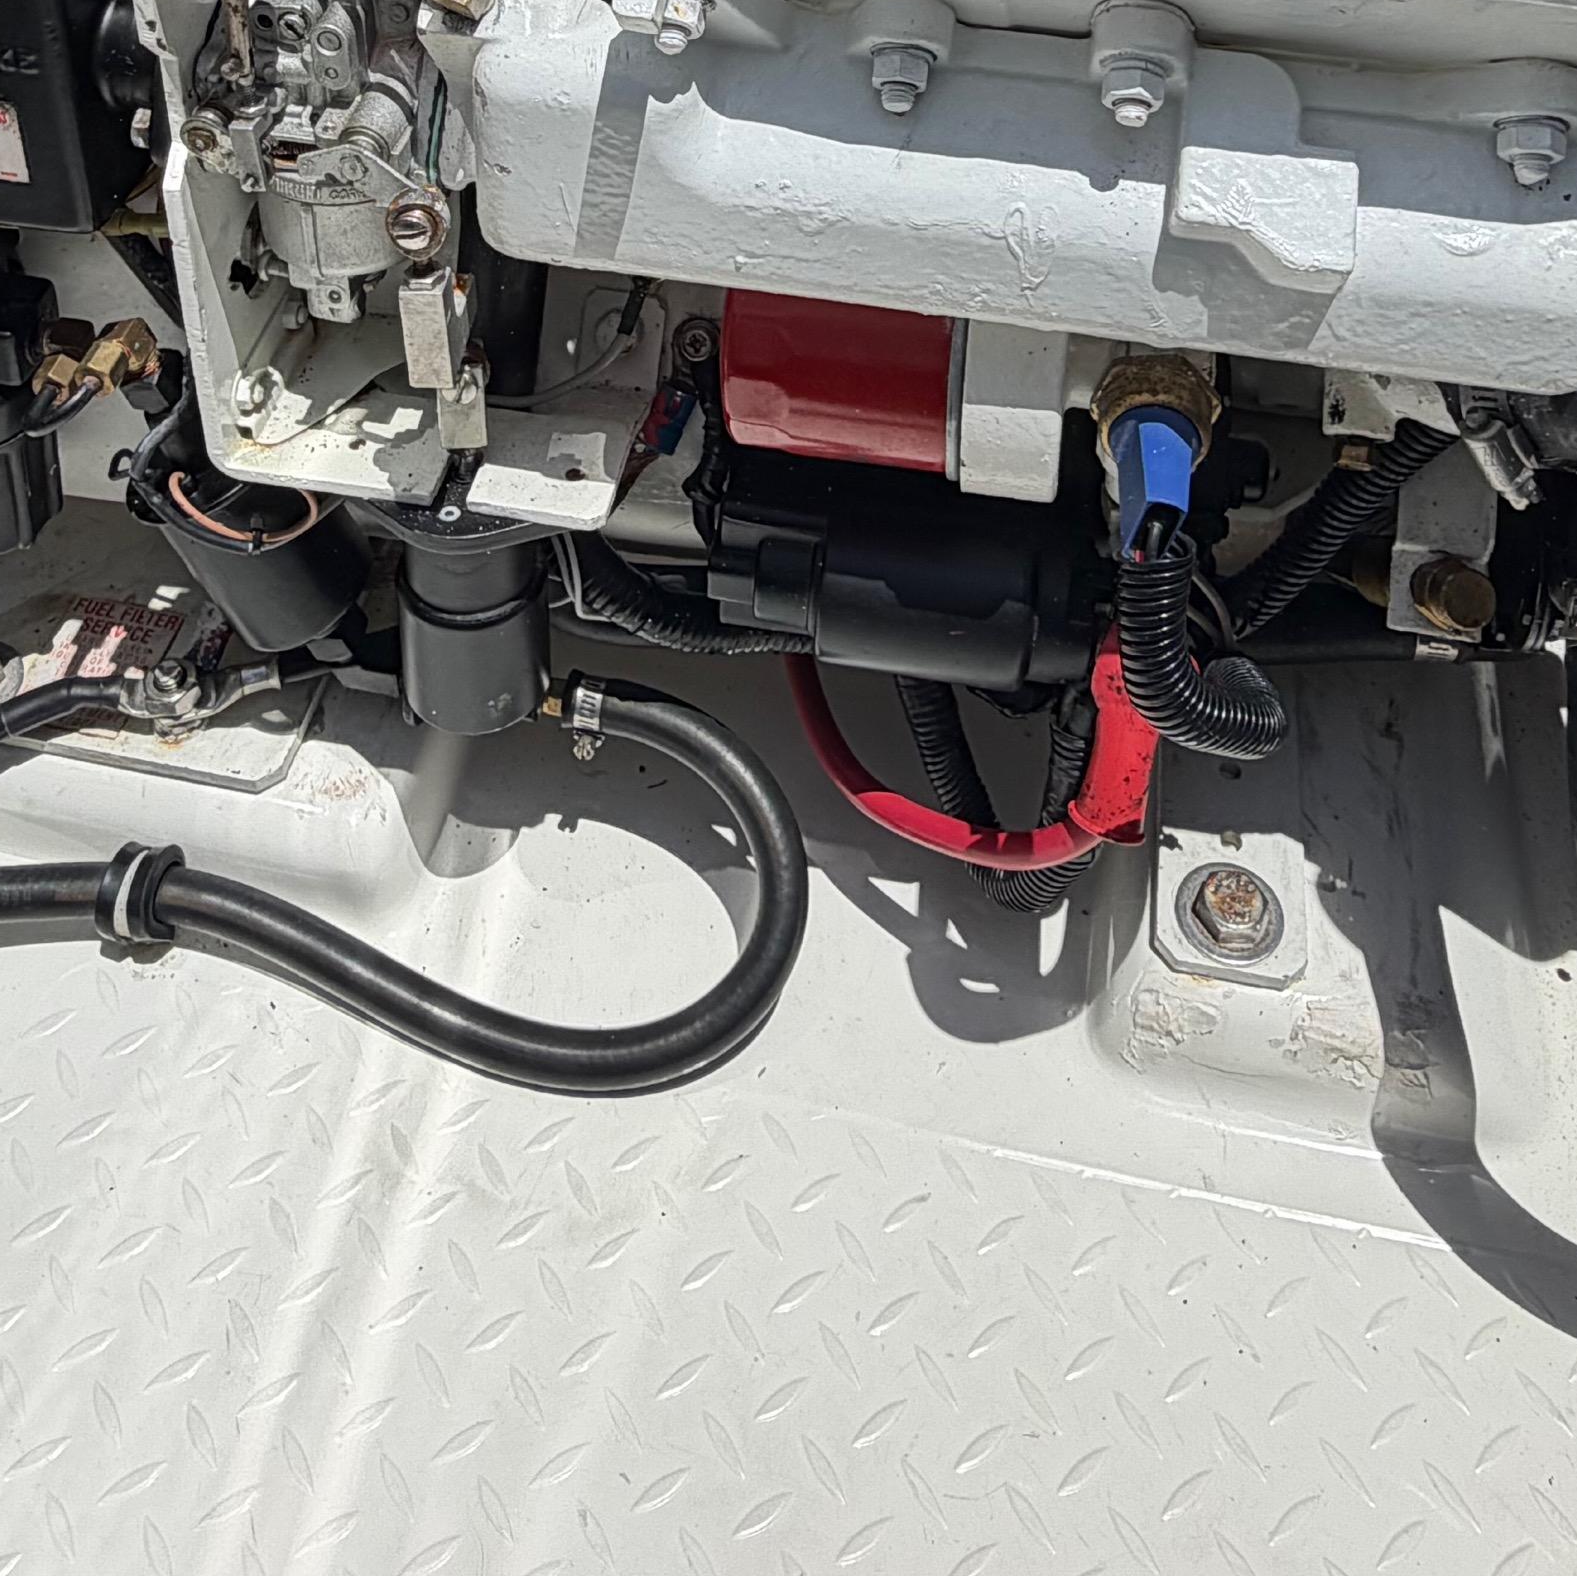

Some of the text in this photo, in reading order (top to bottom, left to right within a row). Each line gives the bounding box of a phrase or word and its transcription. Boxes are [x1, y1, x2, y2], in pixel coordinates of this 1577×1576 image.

[73, 597, 180, 631] FUEL FILTER
[81, 617, 155, 644] SERVICE
